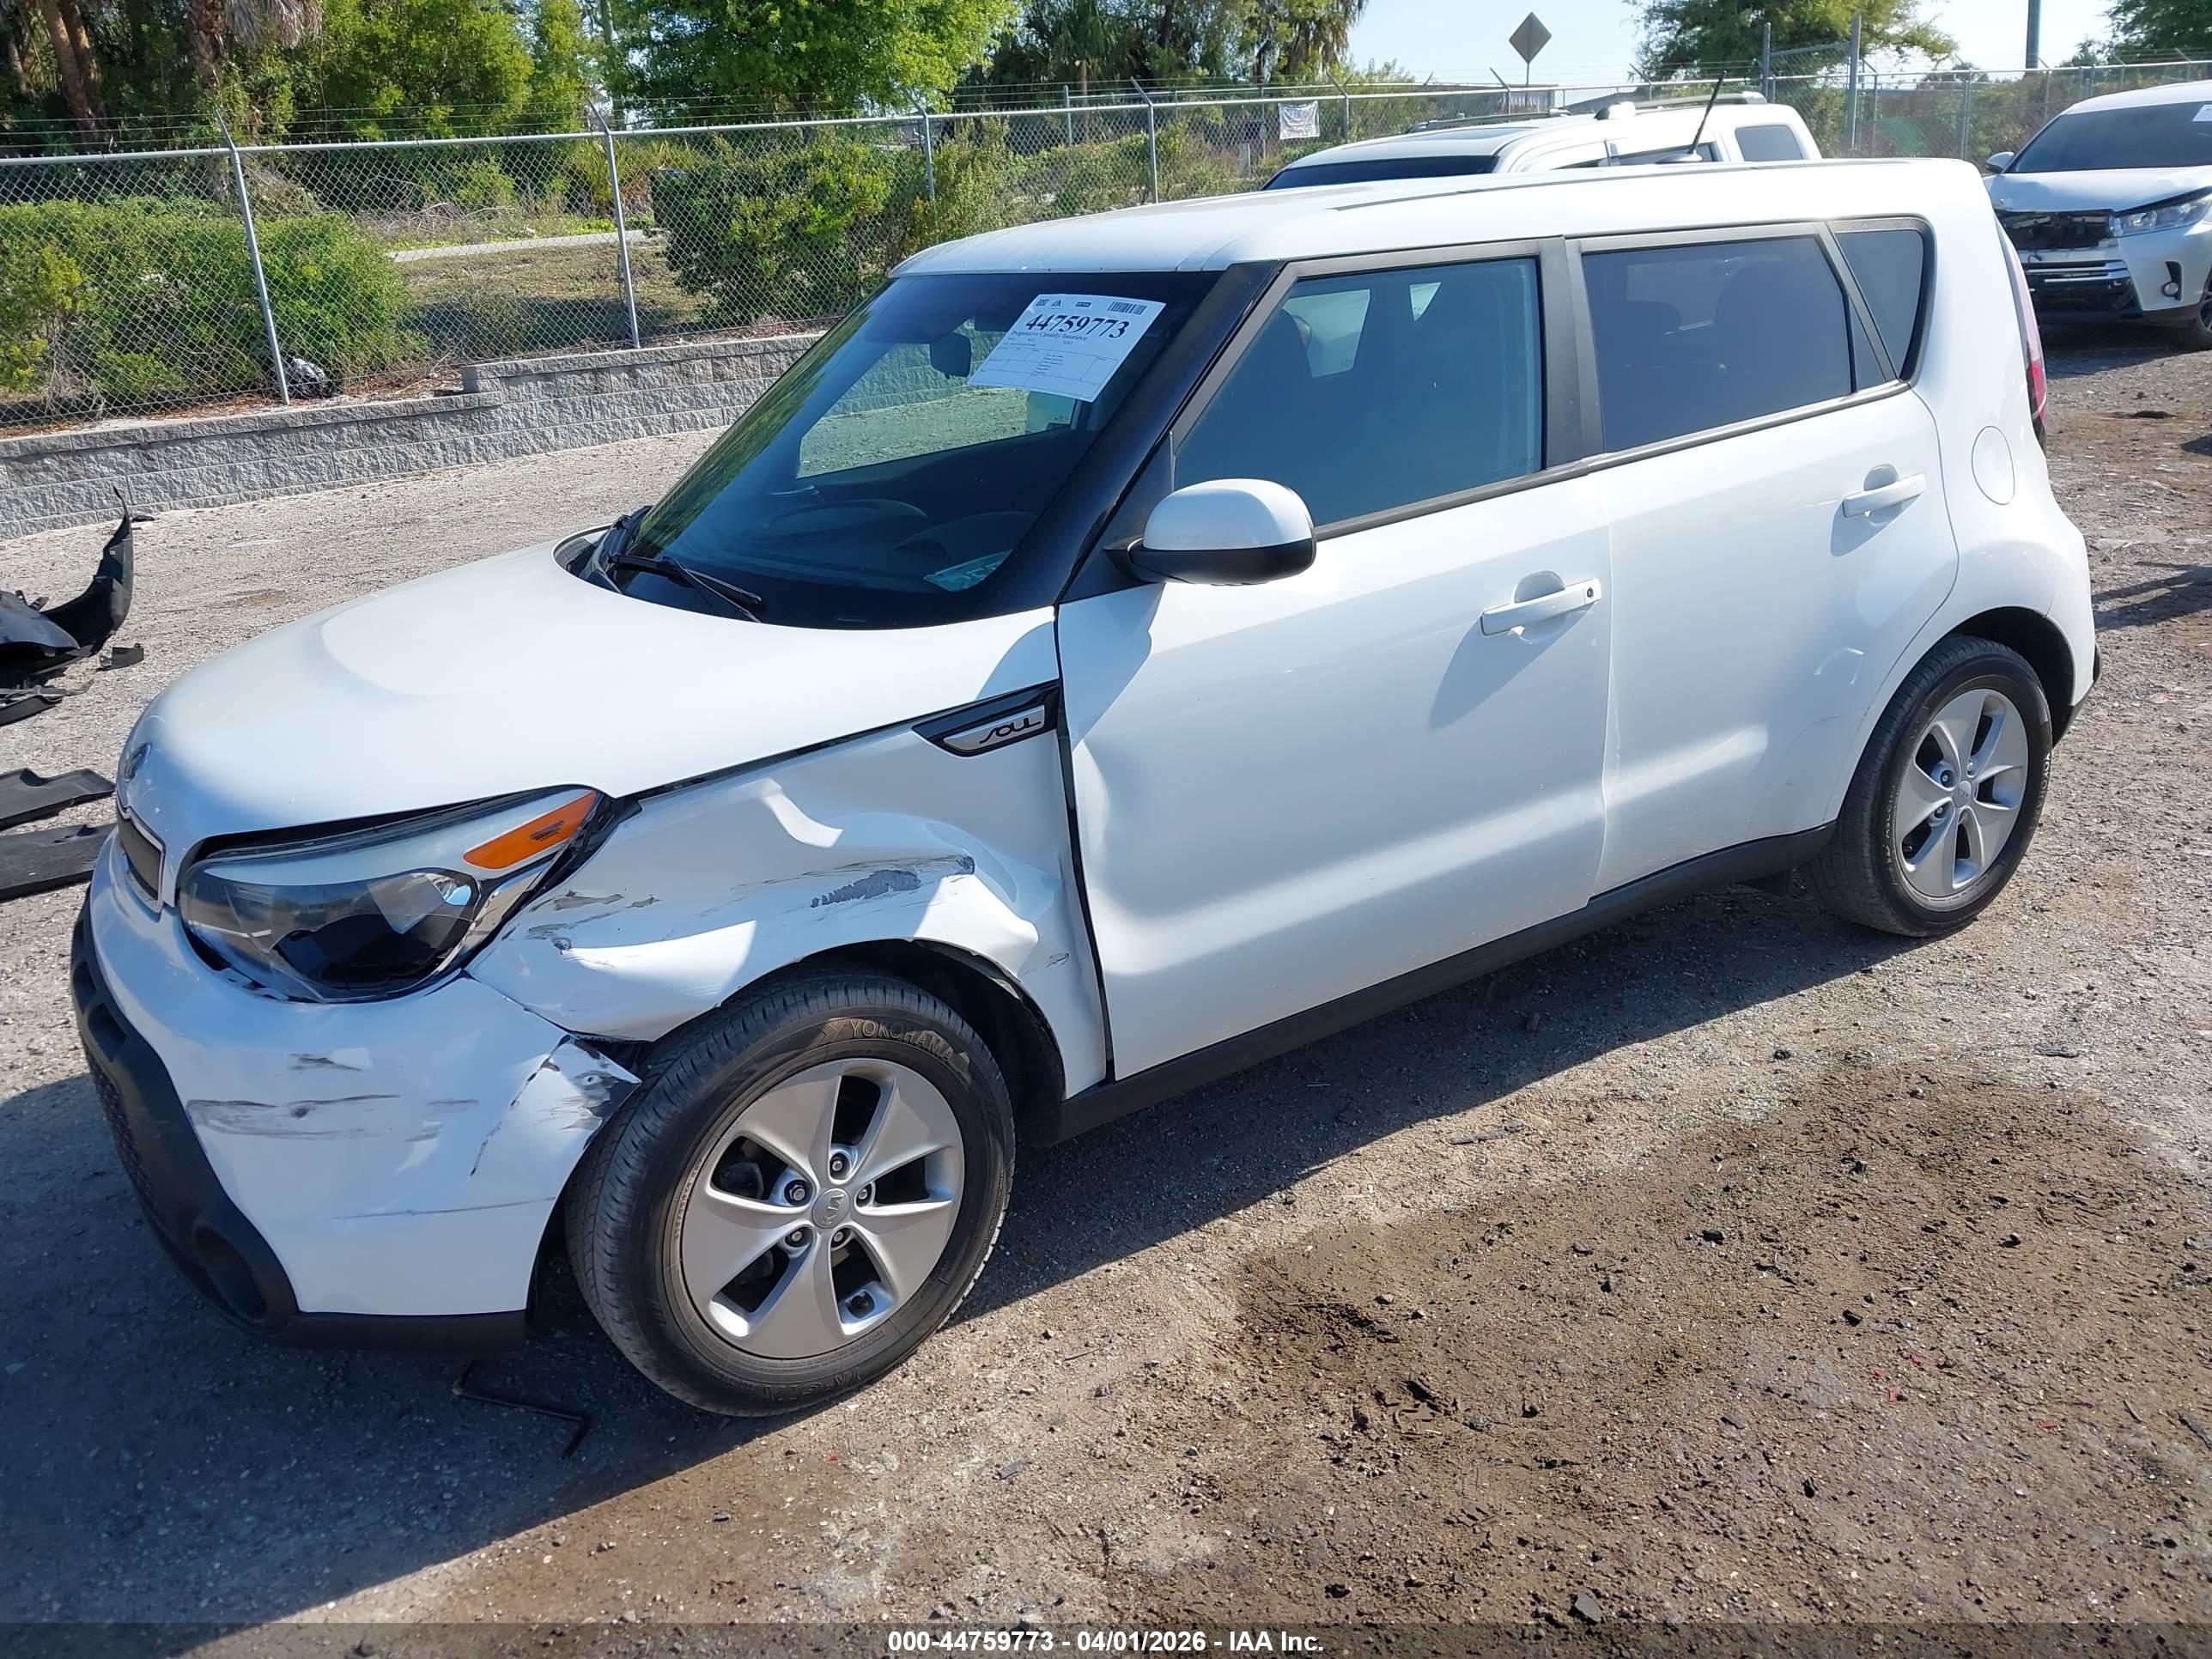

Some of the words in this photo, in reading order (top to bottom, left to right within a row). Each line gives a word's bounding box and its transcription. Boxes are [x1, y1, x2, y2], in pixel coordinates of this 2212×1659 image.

[1025, 313, 1130, 338] 44759773
[979, 717, 1042, 744] SOUL
[849, 1019, 952, 1061] YOKOHAMA
